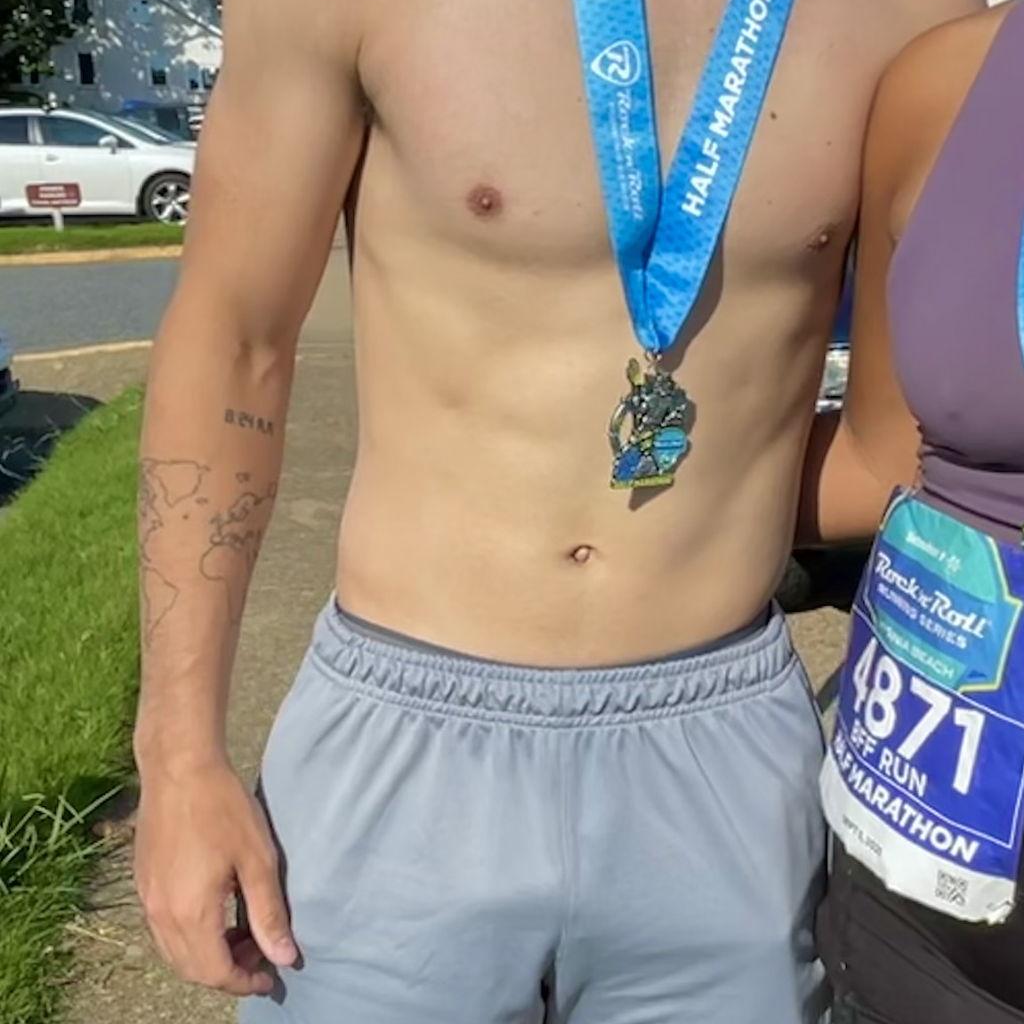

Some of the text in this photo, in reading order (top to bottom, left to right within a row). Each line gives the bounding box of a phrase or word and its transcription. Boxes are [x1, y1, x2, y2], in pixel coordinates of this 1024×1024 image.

[681, 138, 722, 216] HALF
[875, 551, 920, 600] Rock
[930, 589, 986, 640] Roll
[918, 613, 968, 650] SERIES
[852, 636, 986, 796] 4871
[847, 762, 981, 864] MARATHON
[879, 746, 929, 798] RUN
